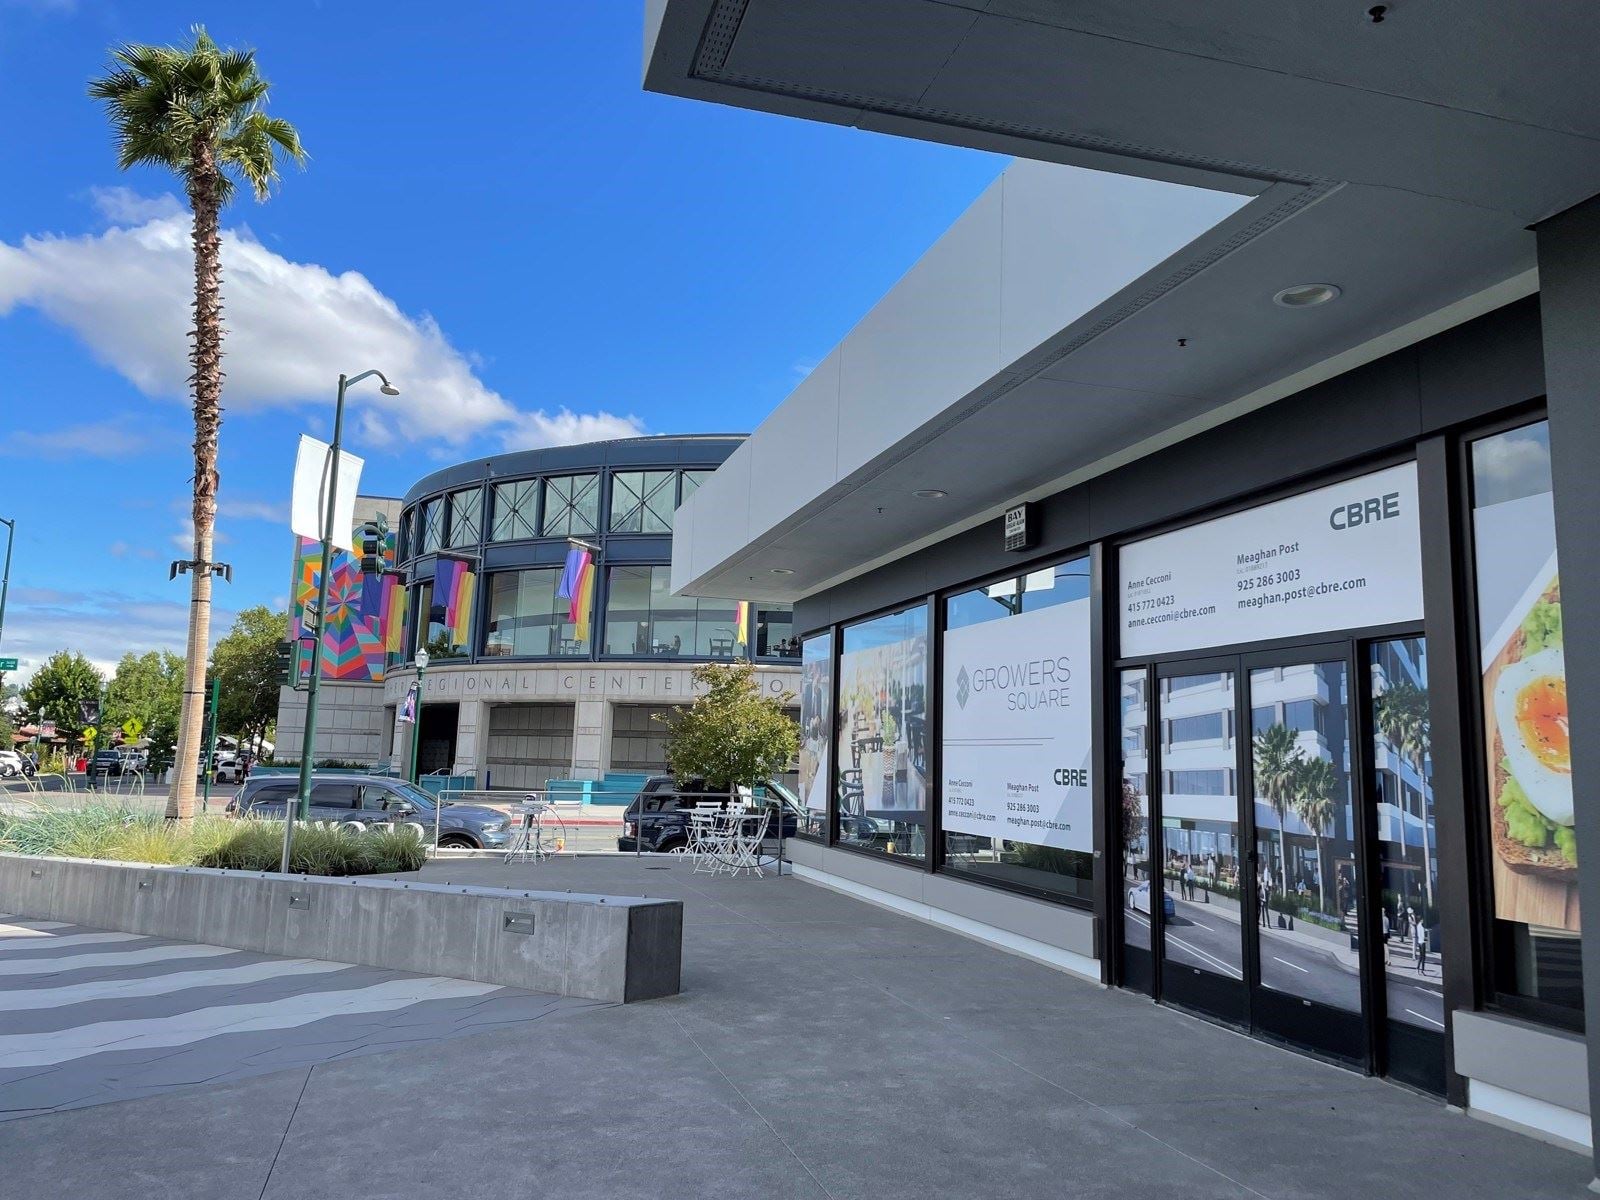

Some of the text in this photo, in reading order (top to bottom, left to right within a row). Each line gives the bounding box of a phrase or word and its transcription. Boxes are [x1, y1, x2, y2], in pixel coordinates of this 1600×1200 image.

[1007, 509, 1023, 522] BAY
[1329, 491, 1400, 530] CBRE
[1236, 541, 1300, 565] Meaghan Post
[1127, 571, 1172, 590] Anne Cecconi
[1237, 569, 1301, 591] 925 286 3003
[1237, 577, 1367, 609] meaghan.post@cbre.com
[1127, 595, 1175, 613] 415 772 0423
[1127, 605, 1216, 628] anne.cecconi@cbre.com
[425, 676, 529, 691] EGIONAL
[563, 676, 700, 691] CENTER
[972, 656, 1071, 692] GROWERS
[1007, 687, 1070, 711] SQUARE
[1007, 782, 1039, 793] Meaghan Post
[1053, 768, 1088, 787] CBRE
[1007, 802, 1016, 811] 925
[1027, 804, 1040, 813] 3003
